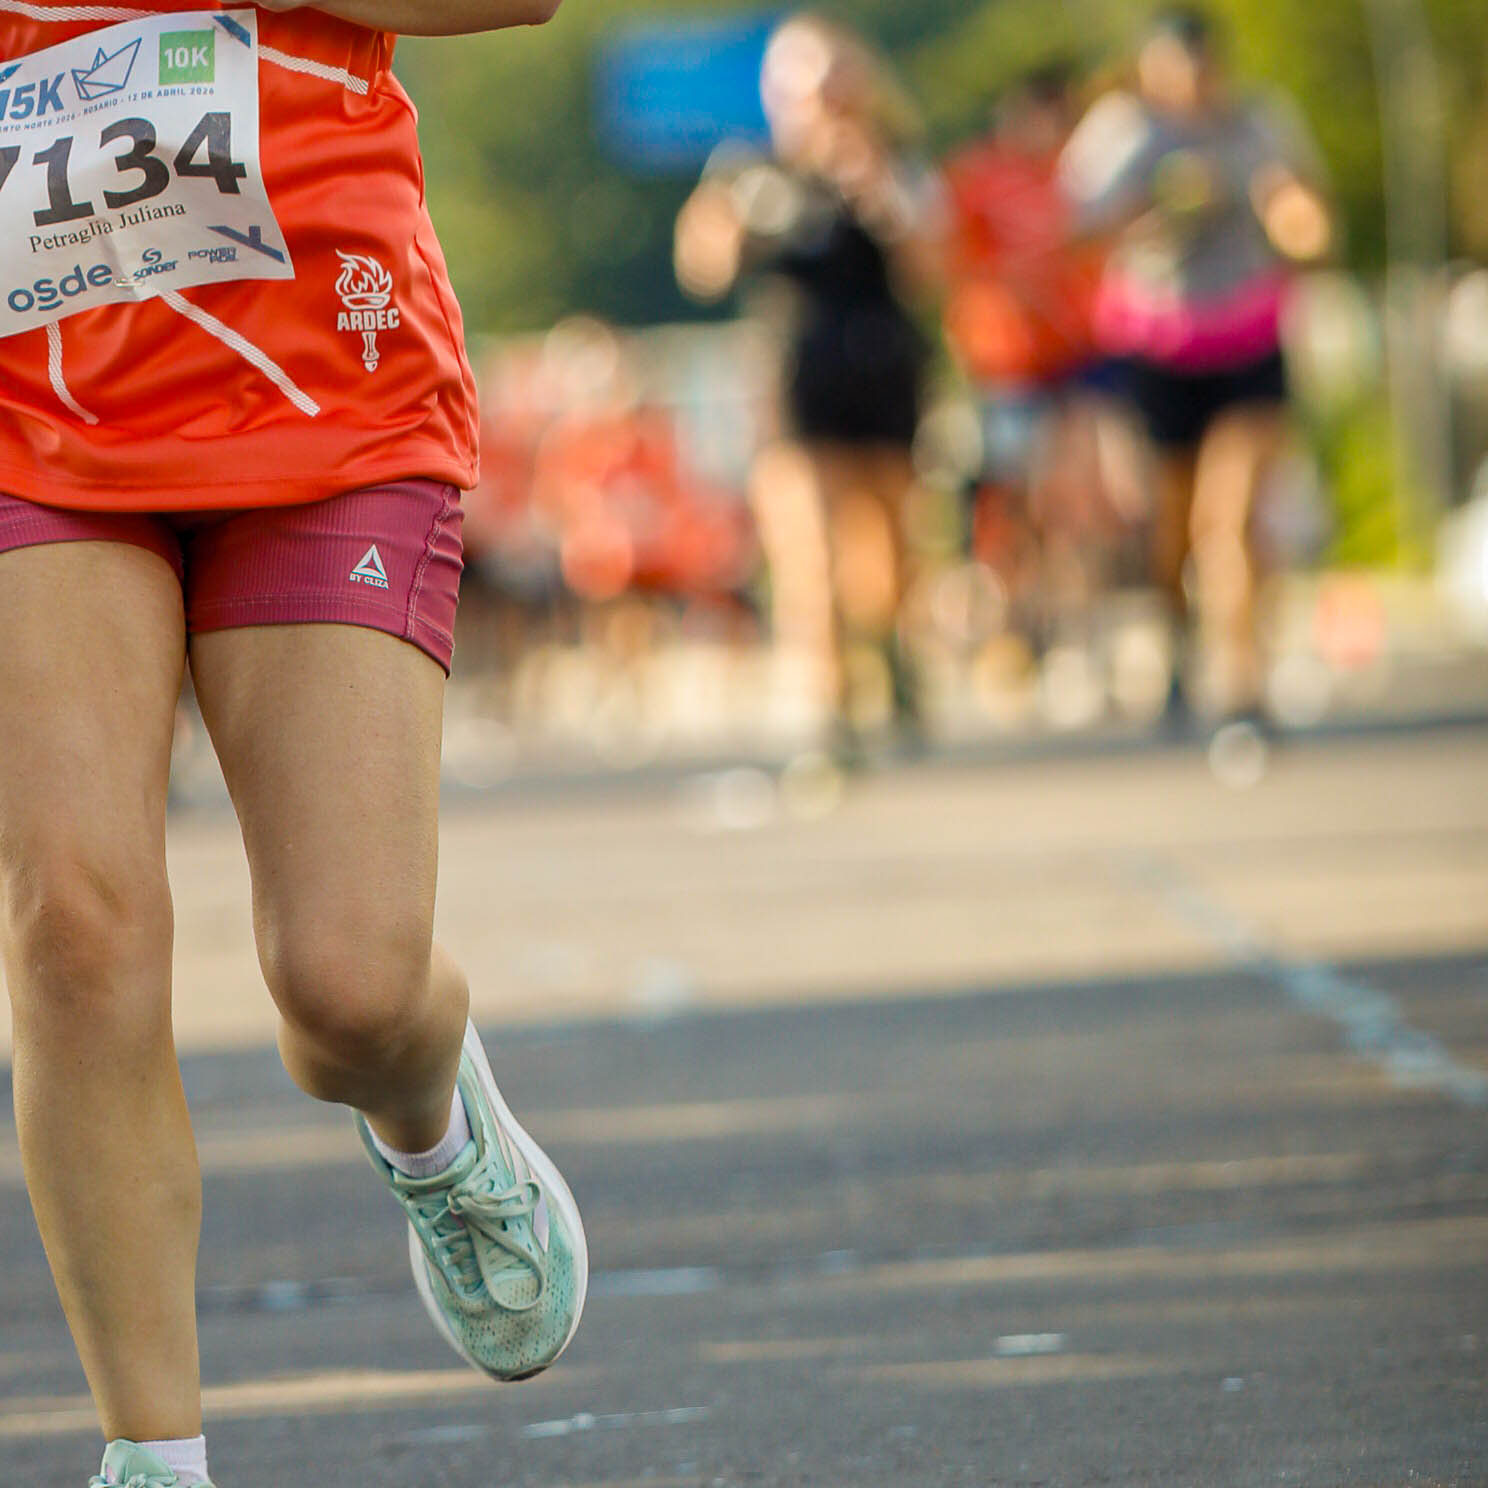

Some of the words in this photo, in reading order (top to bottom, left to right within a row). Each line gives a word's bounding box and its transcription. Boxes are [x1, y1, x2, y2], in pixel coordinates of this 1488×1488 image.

[164, 45, 209, 69] 10K
[29, 218, 113, 253] Petraglia
[118, 202, 187, 229] Juliana
[8, 263, 113, 312] osde
[337, 309, 400, 331] ARDEC
